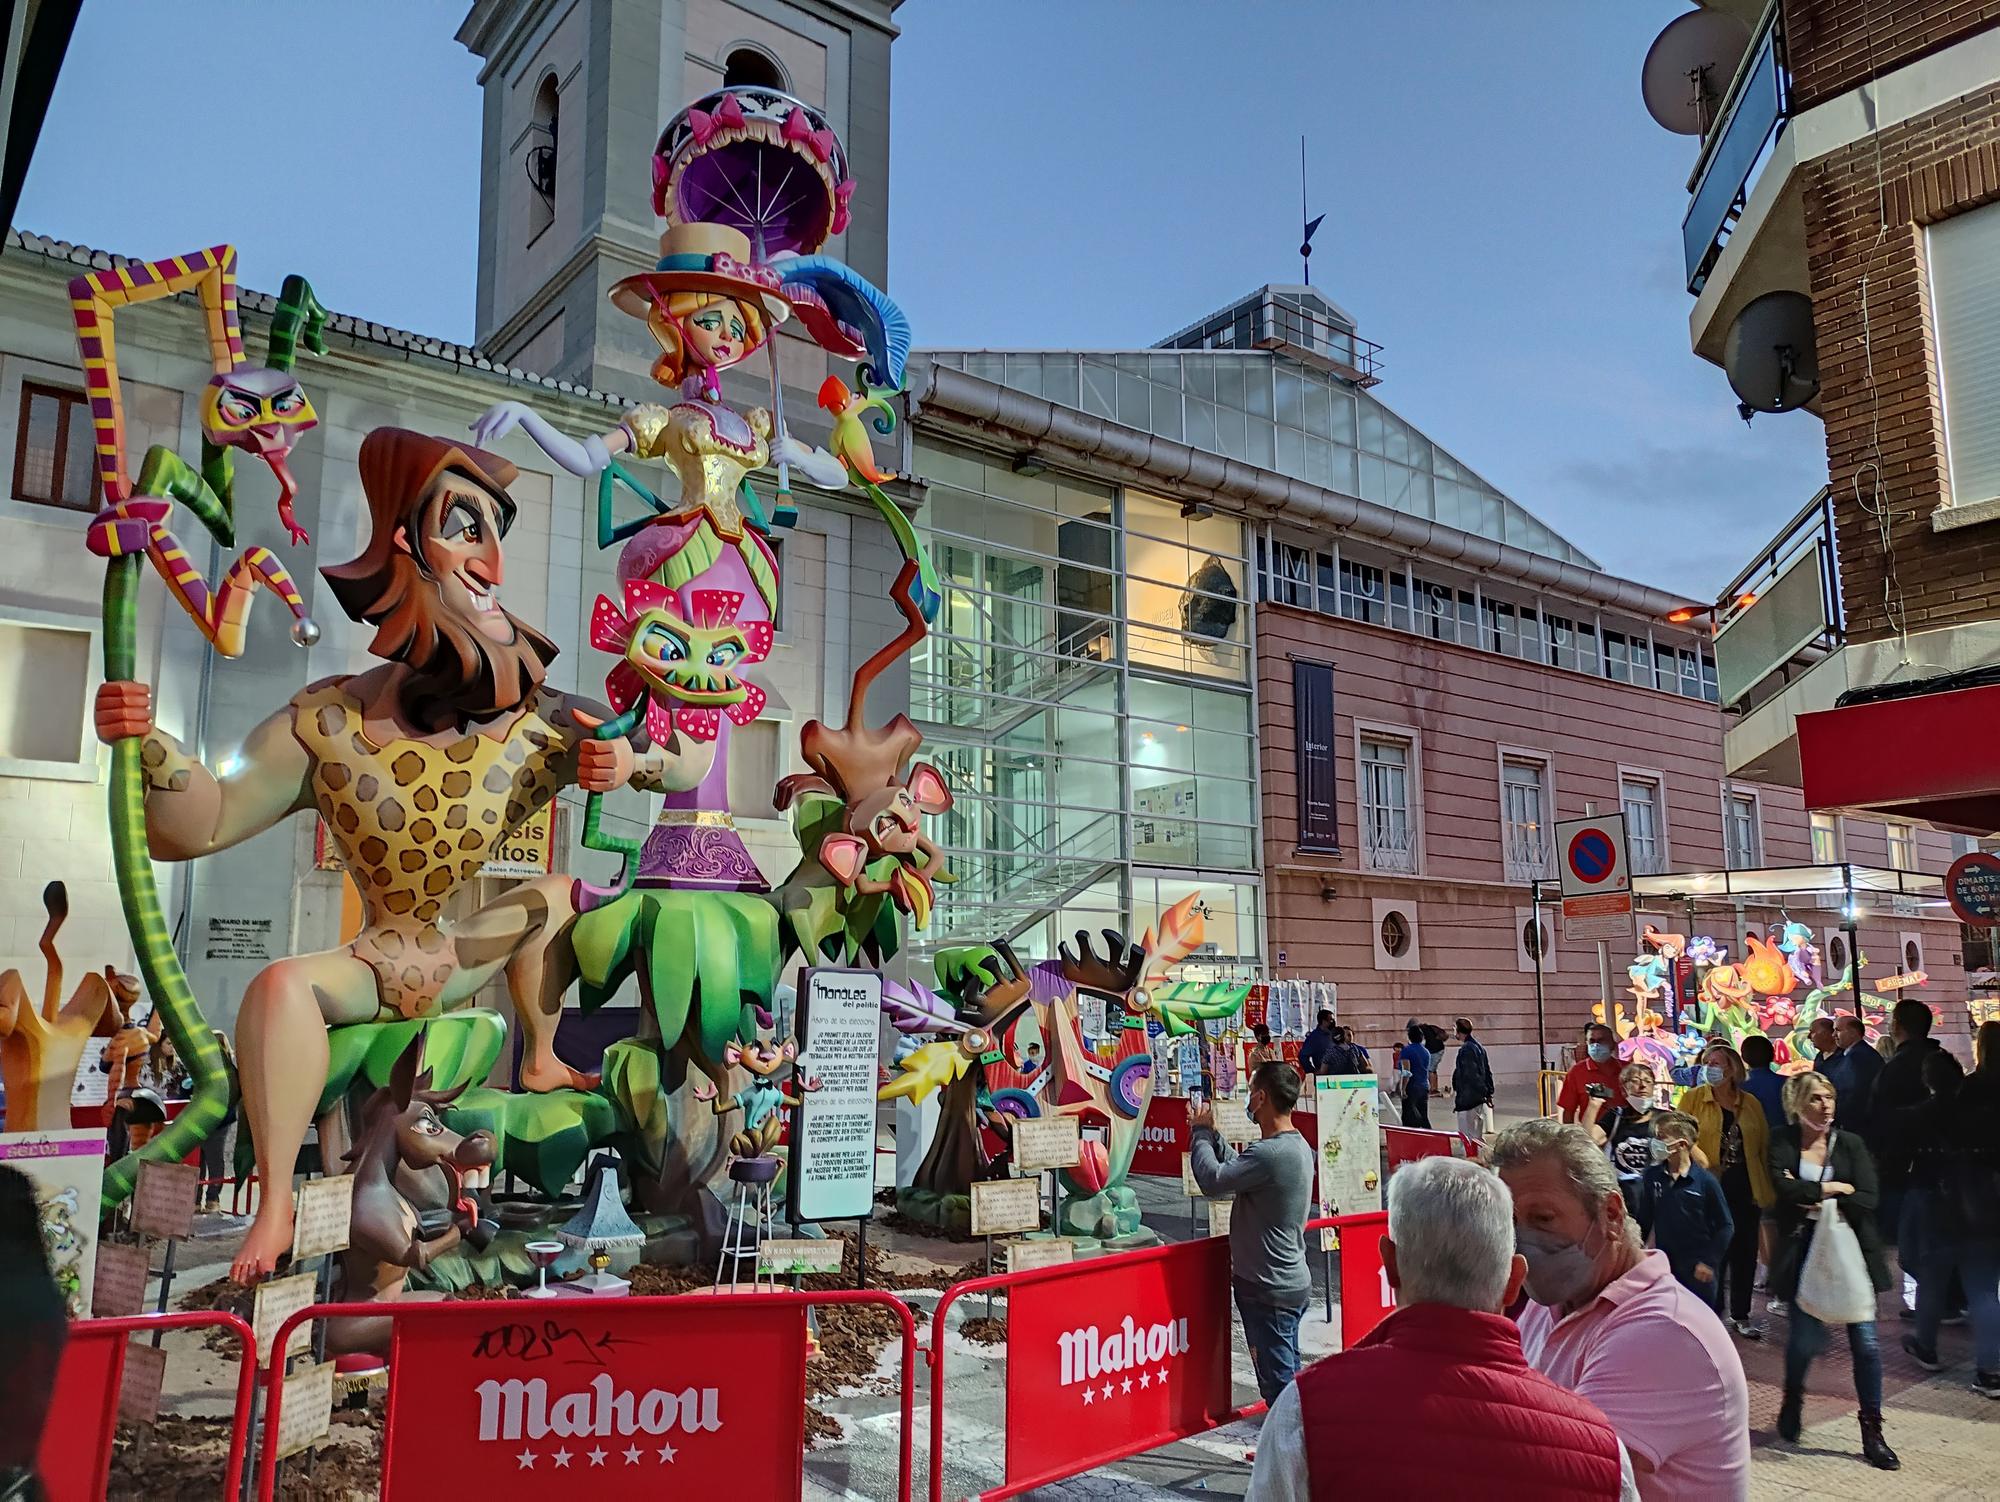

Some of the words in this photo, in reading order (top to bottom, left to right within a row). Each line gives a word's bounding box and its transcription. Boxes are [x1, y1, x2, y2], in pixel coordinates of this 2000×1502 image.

[1957, 875, 1995, 886] DIMARTS
[1056, 1315, 1191, 1387] Mahou
[474, 1372, 724, 1441] Mahou
